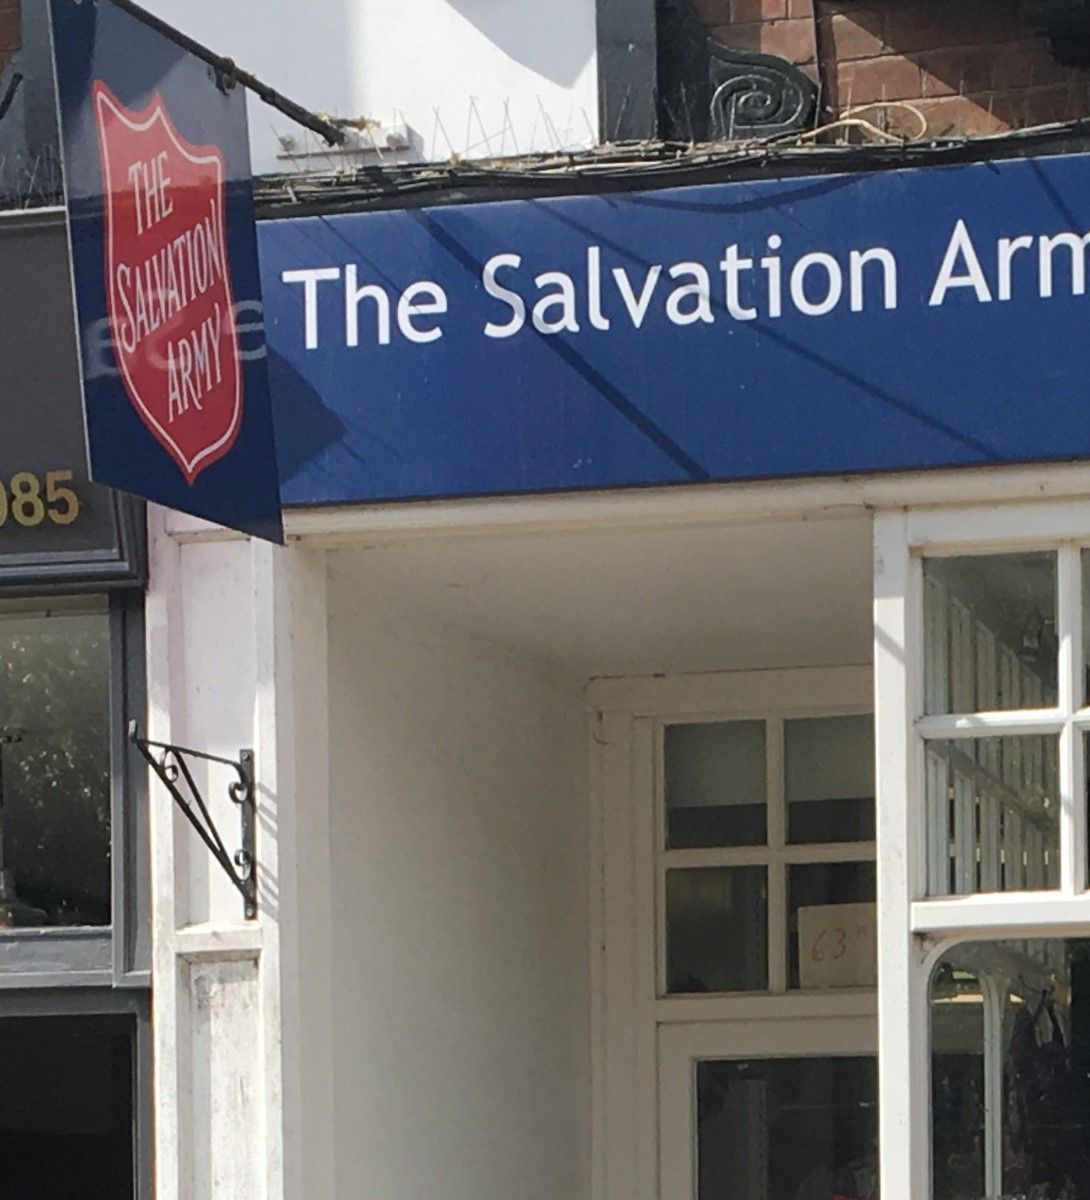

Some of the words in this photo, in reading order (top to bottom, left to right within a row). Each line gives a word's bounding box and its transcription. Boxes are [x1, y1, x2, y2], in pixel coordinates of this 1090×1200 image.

[128, 150, 174, 236] THE
[115, 198, 224, 354] SALVATION
[281, 264, 448, 350] The
[482, 234, 898, 339] Salvation
[166, 302, 223, 424] ARMY
[0, 470, 80, 527] 85
